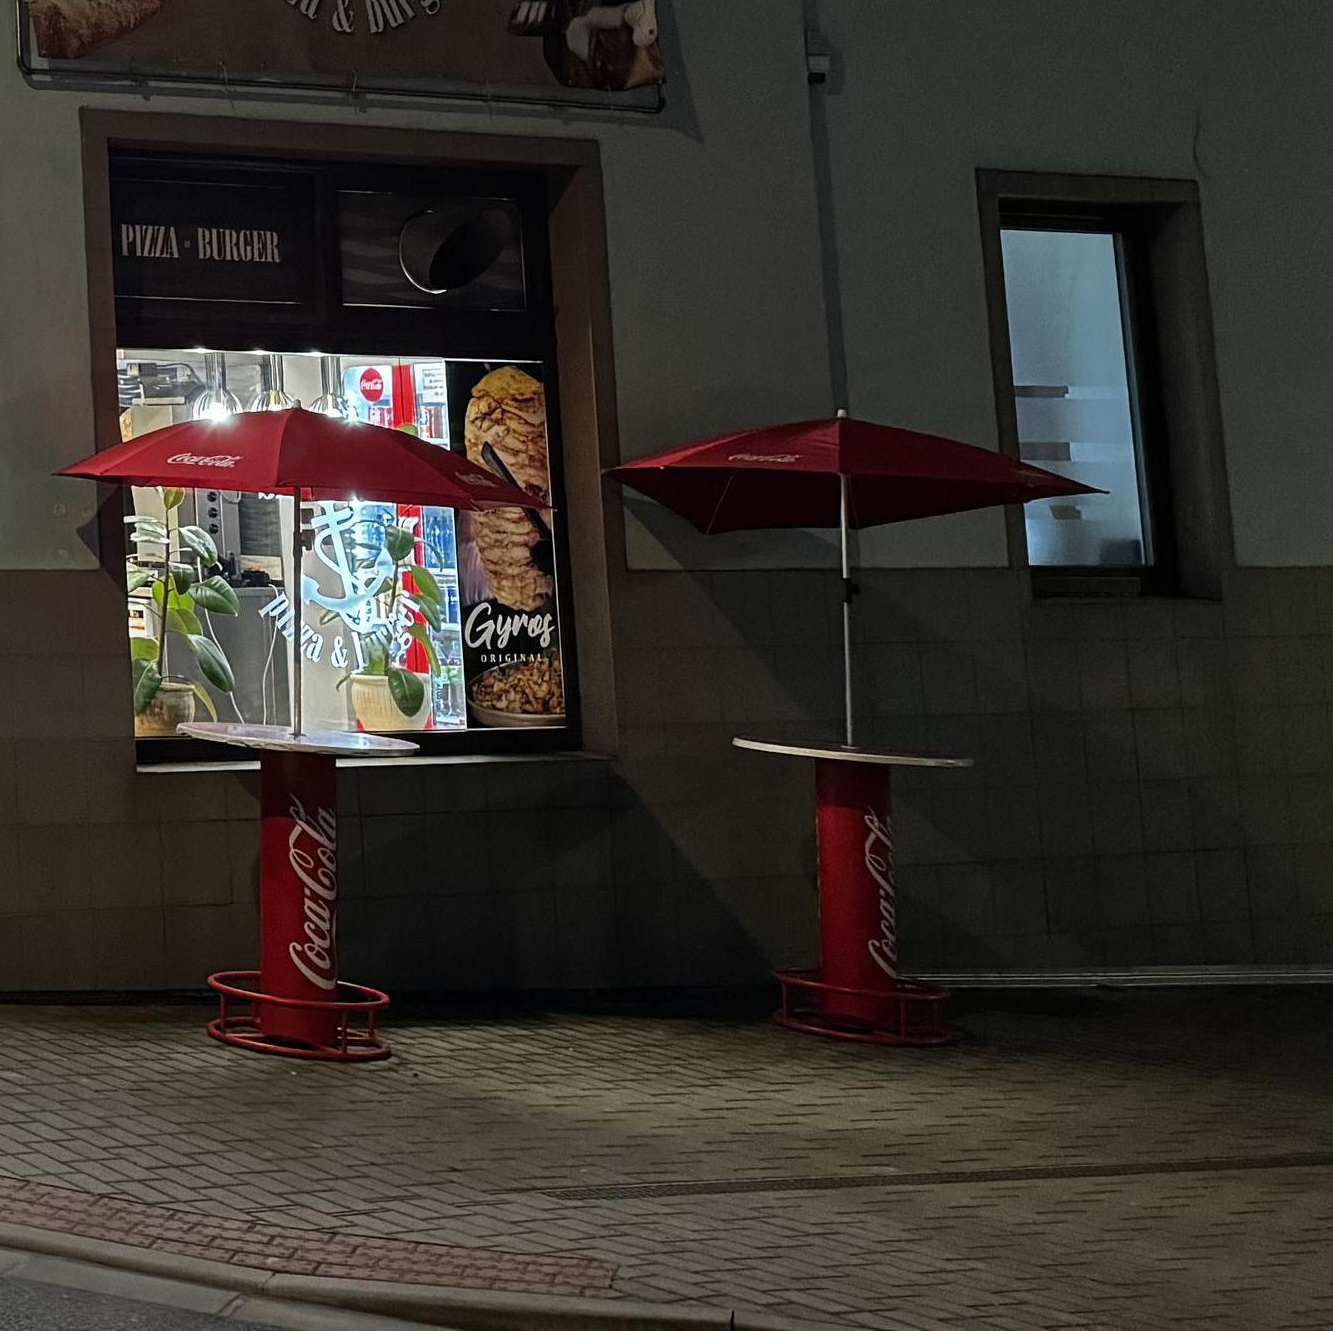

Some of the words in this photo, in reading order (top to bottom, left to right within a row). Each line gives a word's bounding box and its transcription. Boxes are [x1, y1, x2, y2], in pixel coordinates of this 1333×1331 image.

[120, 223, 180, 258] PIZZA
[197, 227, 282, 263] BURGER
[464, 601, 556, 650] Gyros
[331, 635, 348, 668] &
[480, 653, 542, 664] ORIGINAL
